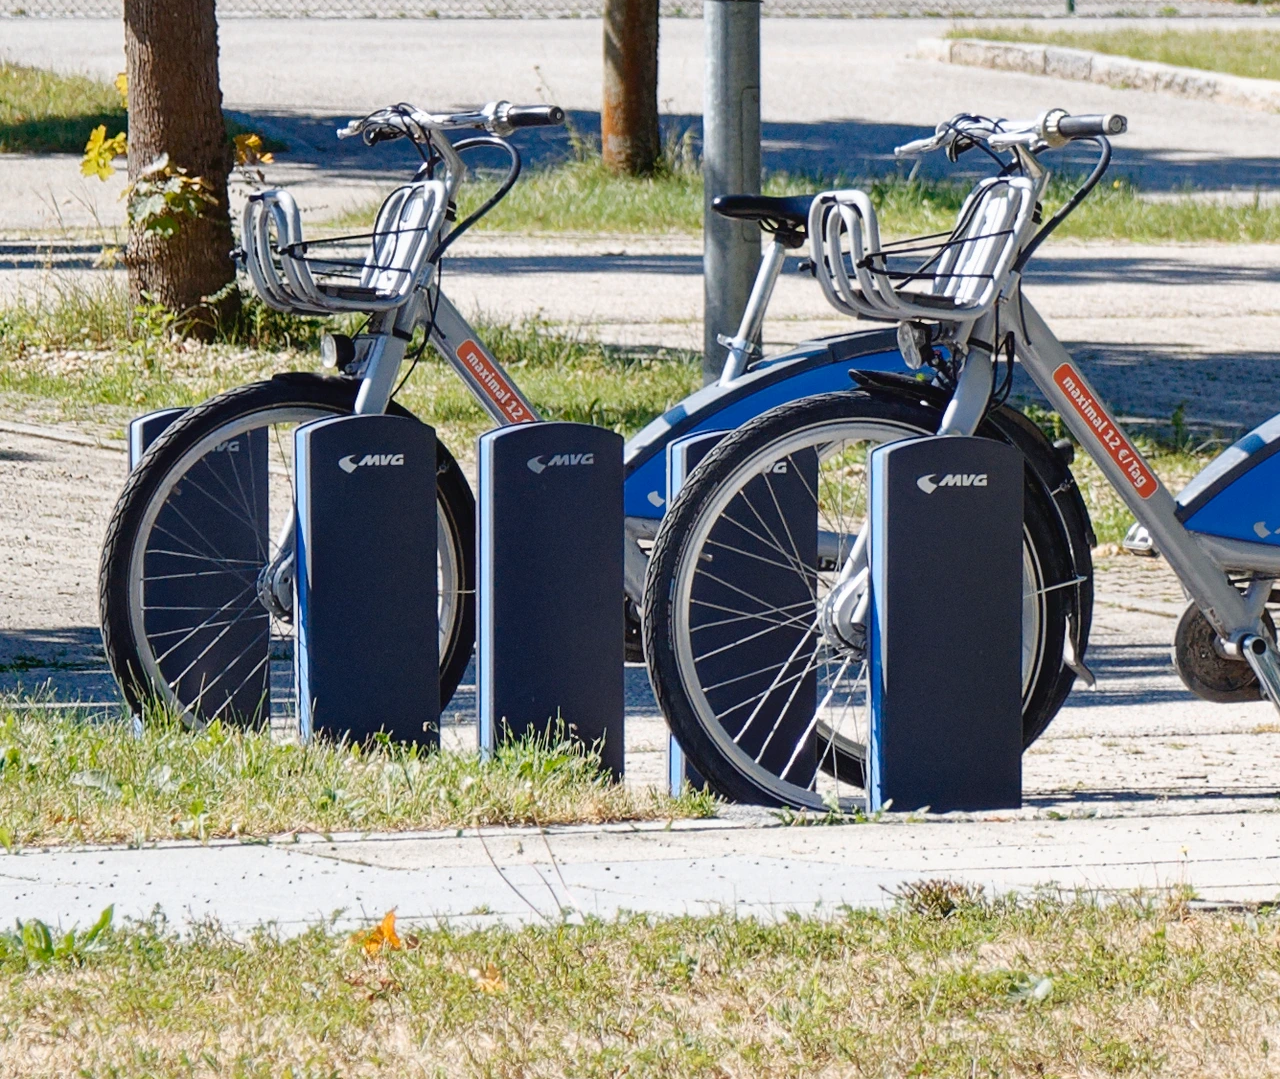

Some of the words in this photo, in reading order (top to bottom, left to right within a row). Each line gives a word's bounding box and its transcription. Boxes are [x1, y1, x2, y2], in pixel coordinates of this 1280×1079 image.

[467, 352, 511, 404] maximal
[506, 401, 523, 420] 12
[1062, 377, 1107, 432] maximal
[1103, 429, 1121, 450] 12
[1118, 449, 1147, 488] €/Tag
[358, 454, 404, 466] MVG
[548, 453, 594, 465] MVG
[938, 474, 987, 486] MVG
